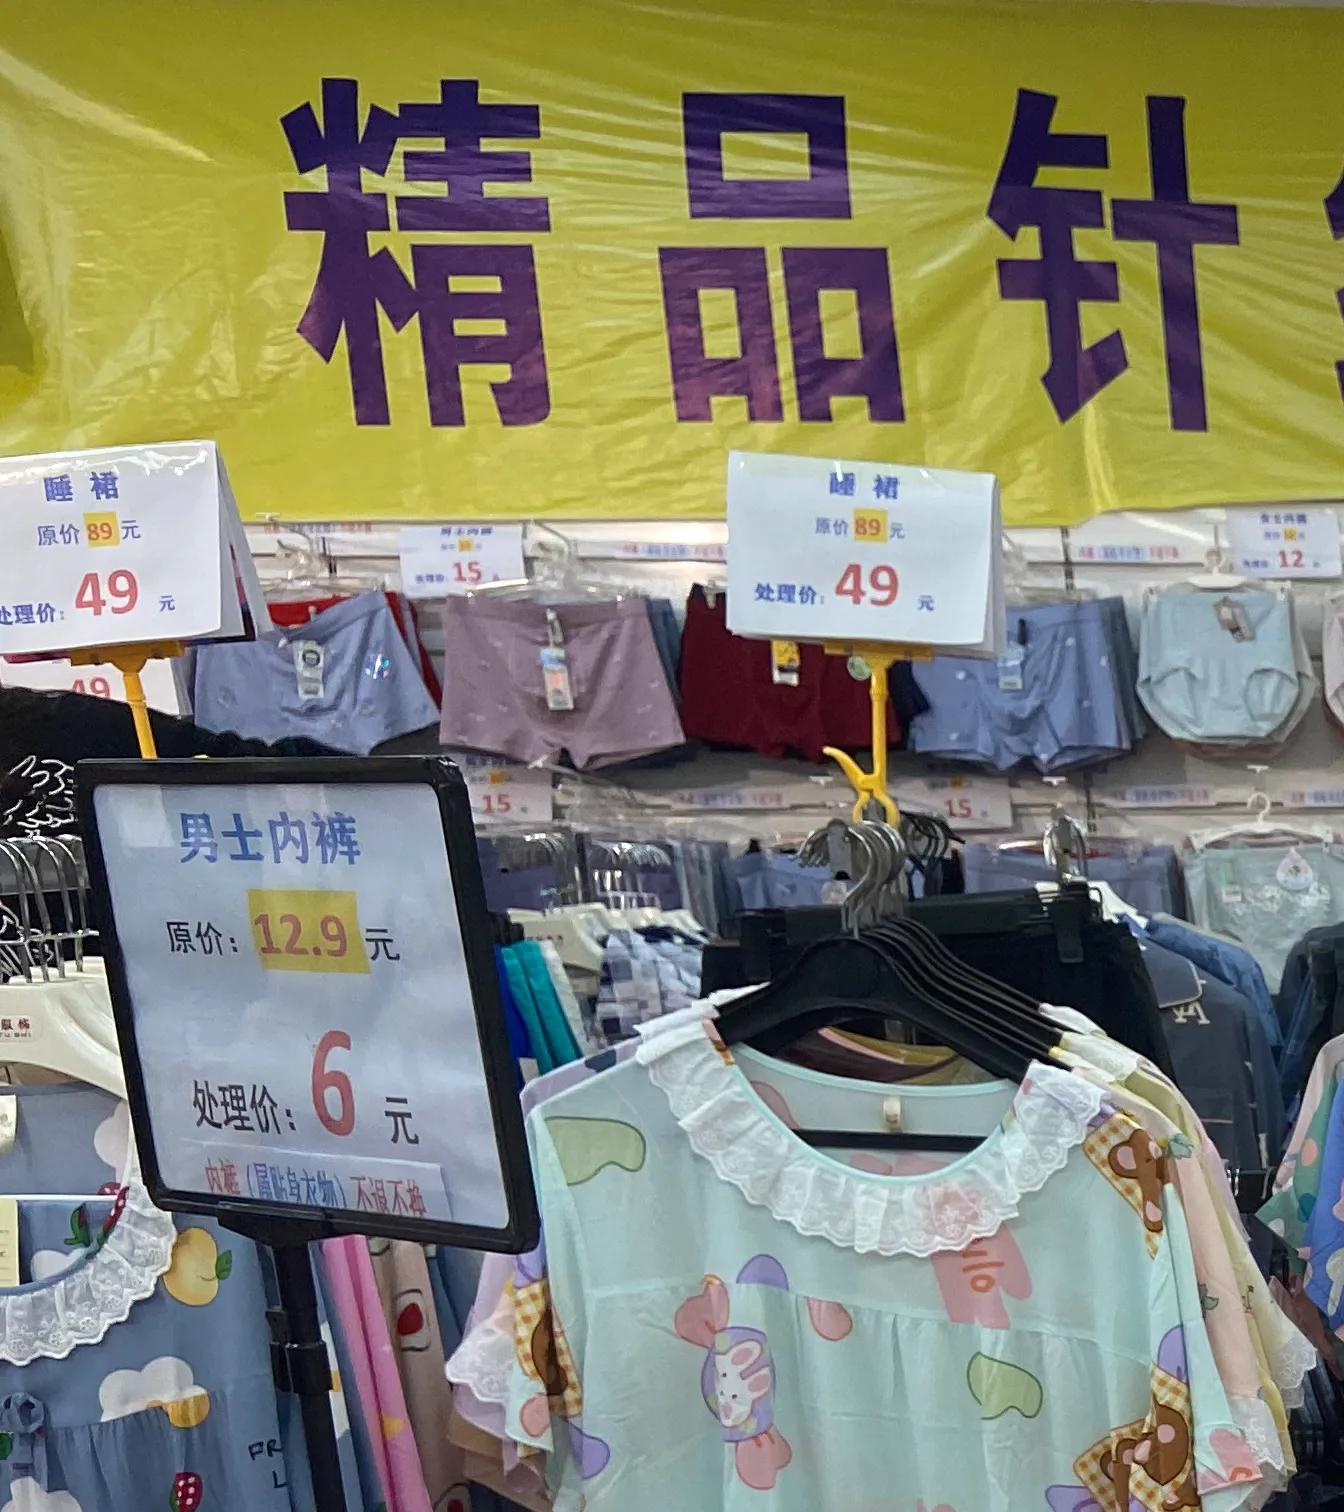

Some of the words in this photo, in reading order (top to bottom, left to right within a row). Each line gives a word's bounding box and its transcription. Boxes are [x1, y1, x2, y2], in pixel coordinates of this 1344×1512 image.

[44, 471, 120, 502] 睡裙
[828, 470, 900, 501] 睡裙
[453, 561, 483, 584] 15
[1278, 549, 1305, 568] 12
[74, 567, 139, 618] 49
[834, 563, 900, 608] 49
[179, 811, 362, 865] 男士内裤
[254, 913, 349, 958] 12.9
[365, 928, 401, 962] 元
[311, 1029, 356, 1137] 6
[384, 1096, 420, 1145] 元
